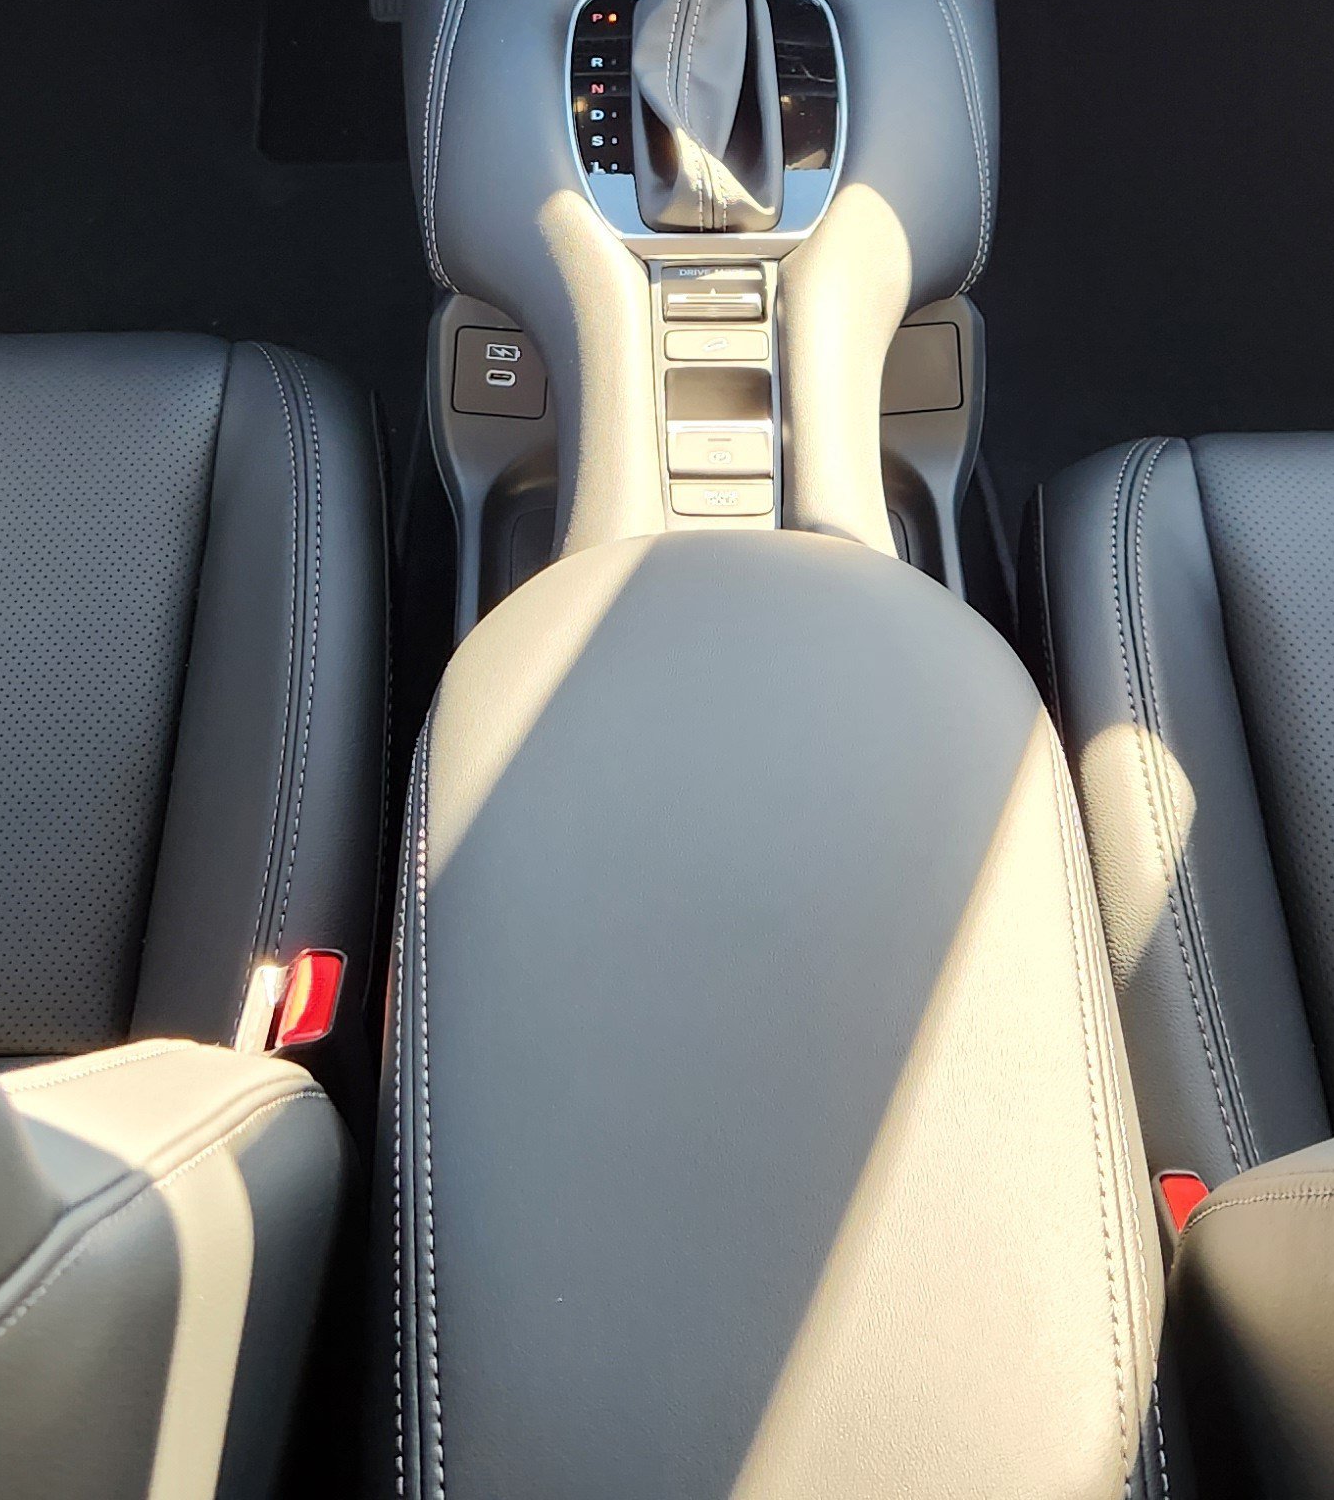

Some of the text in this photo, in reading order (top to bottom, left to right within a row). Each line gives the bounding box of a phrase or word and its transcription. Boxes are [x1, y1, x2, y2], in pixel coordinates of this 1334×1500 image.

[592, 13, 603, 23] P
[591, 57, 604, 68] R
[591, 84, 604, 94] N
[590, 109, 605, 120] D
[591, 135, 604, 147] S
[679, 268, 708, 276] DRIVE
